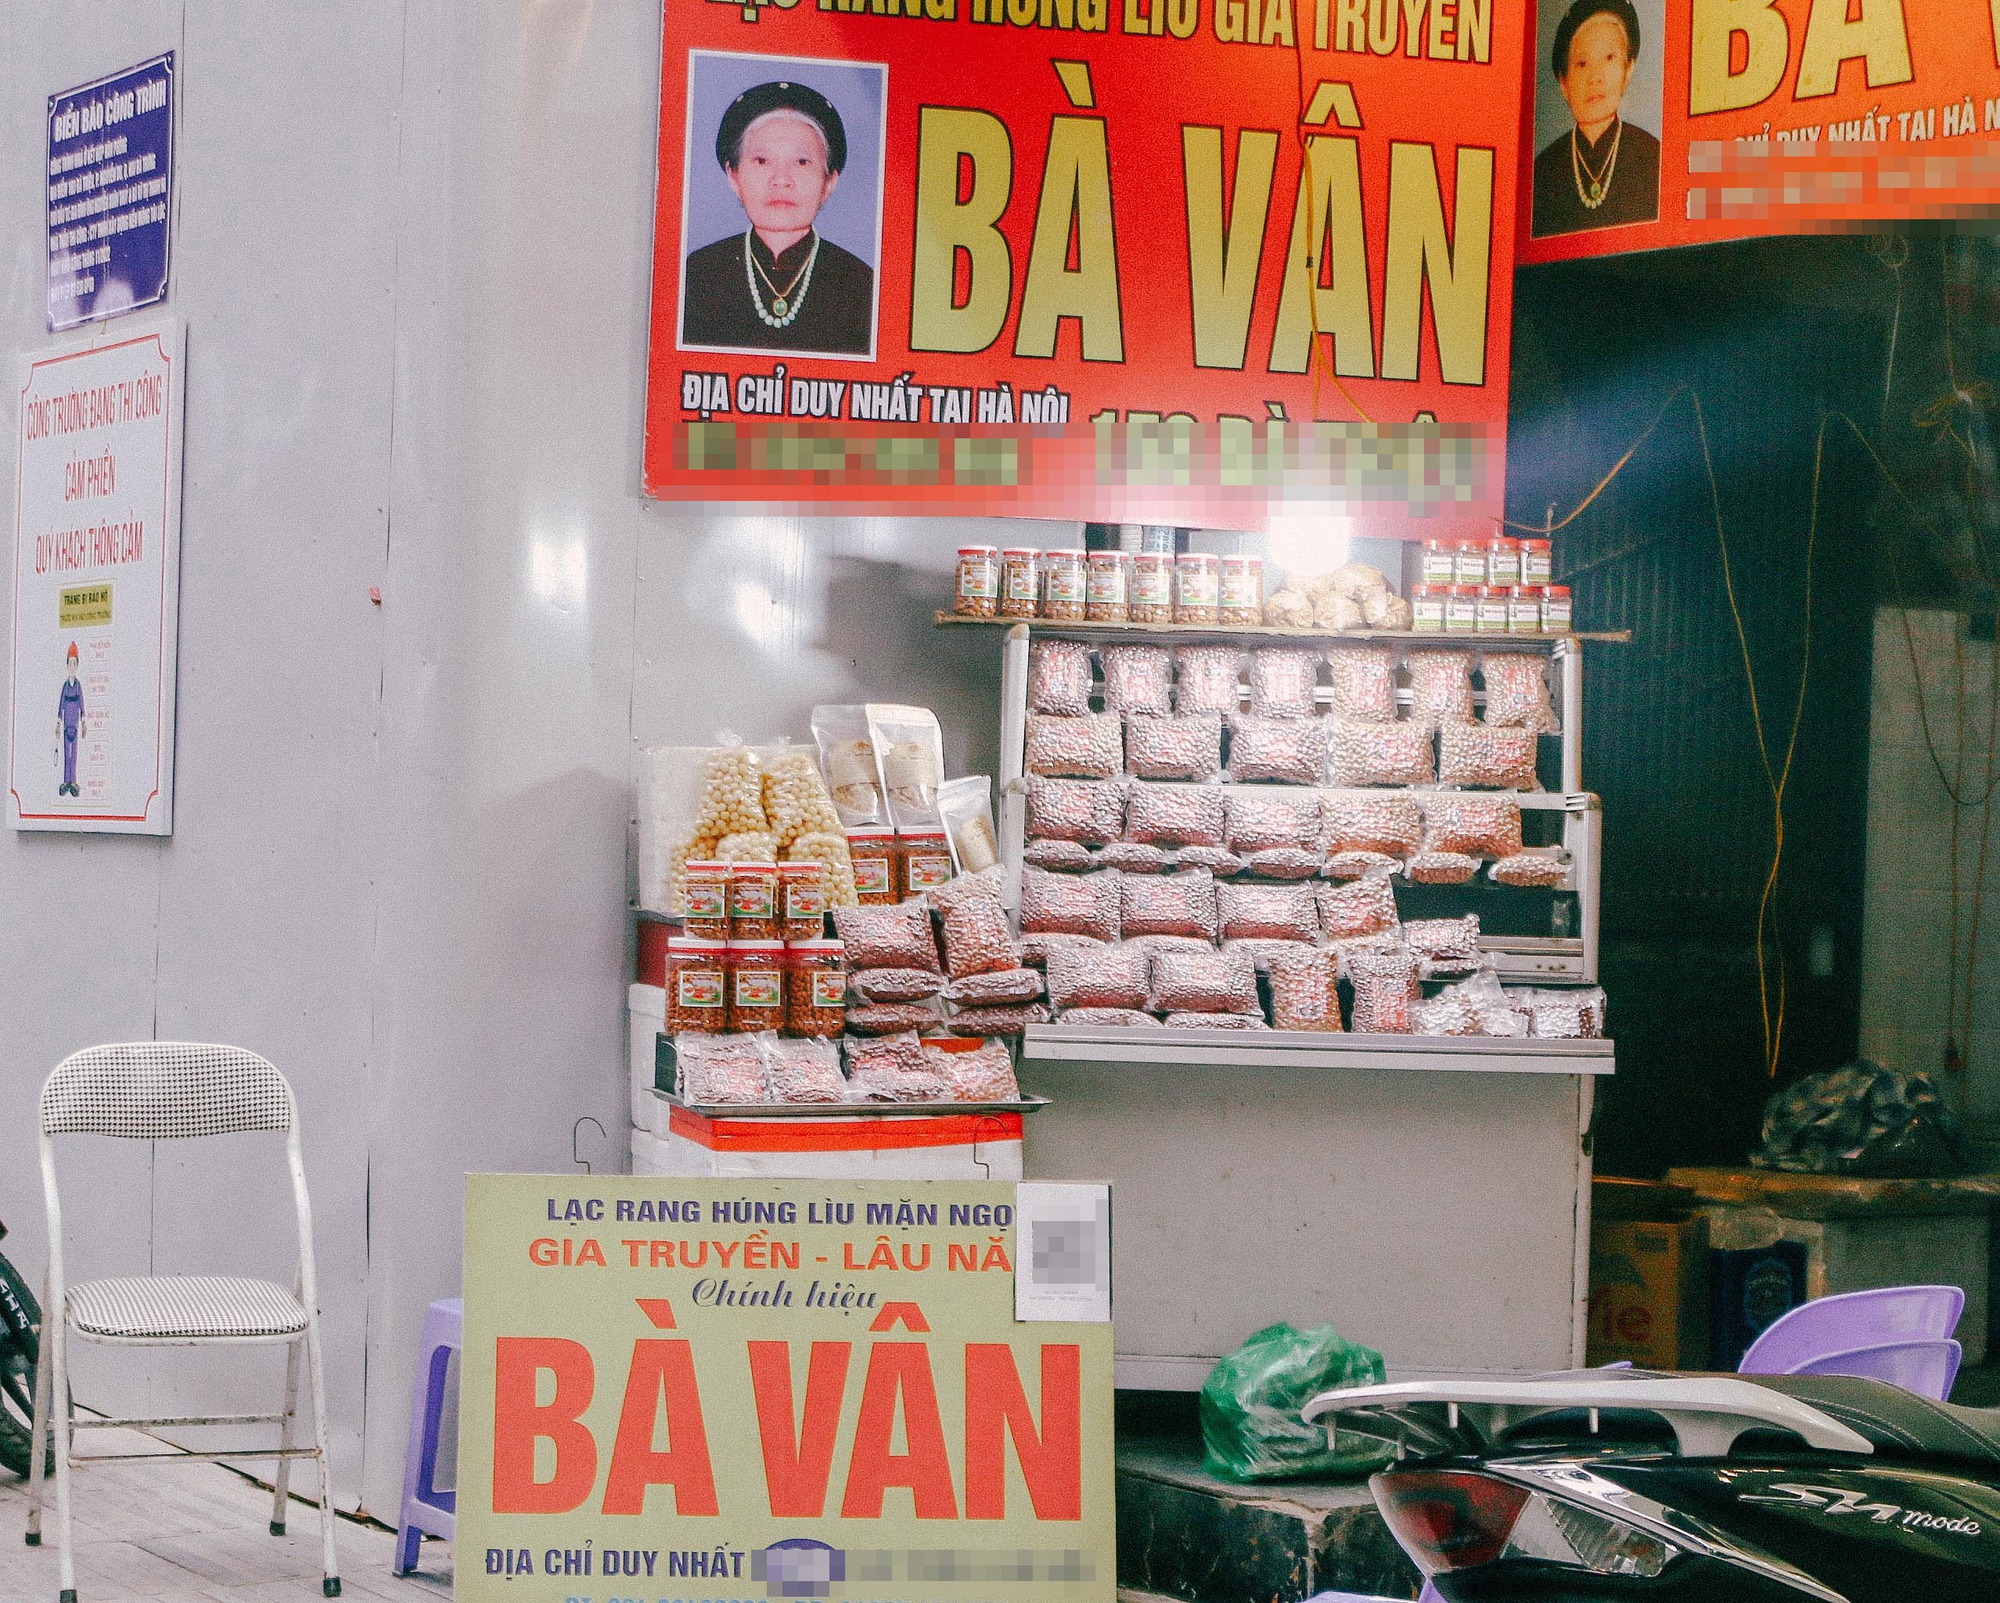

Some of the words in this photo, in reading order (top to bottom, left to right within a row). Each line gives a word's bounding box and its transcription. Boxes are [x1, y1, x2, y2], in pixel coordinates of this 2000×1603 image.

[81, 98, 104, 134] BÁO
[105, 90, 135, 126] CÔNG
[135, 79, 166, 115] TRÌNH
[1942, 95, 1978, 138] HÀ
[909, 60, 1127, 364] BÀ
[1181, 81, 1498, 387] VÂN
[27, 393, 51, 441] CÔNG
[90, 385, 116, 428] ĐANG
[118, 380, 134, 423] THI
[135, 369, 162, 419] CÔNG
[682, 371, 732, 420] ĐỊA
[736, 363, 787, 416] CHỈ
[789, 377, 848, 419] DUY
[850, 371, 926, 423] NHẤT
[977, 381, 1016, 424] HÀ
[56, 523, 87, 571] KHÁCH
[89, 518, 120, 568] THÔNG
[547, 1198, 605, 1227] LẠC
[616, 1200, 701, 1224] RANG
[712, 1197, 797, 1225] HÚNG
[808, 1198, 855, 1225] LÌU
[866, 1198, 938, 1231] MẶN
[949, 1204, 1014, 1232] NGỌ
[528, 1237, 608, 1268] GIA
[621, 1228, 800, 1270] TRUYỀN
[843, 1235, 932, 1272] LÂU
[948, 1236, 1013, 1273] NĂ
[692, 1278, 794, 1308] Chính
[805, 1280, 880, 1317] hiệu
[492, 1298, 720, 1517] BÀ
[747, 1302, 1082, 1521] VÂN
[1902, 1508, 1982, 1536] mode
[485, 1548, 534, 1581] ĐỊA
[544, 1539, 593, 1576] CHỈ
[602, 1550, 659, 1577] DUY
[668, 1542, 746, 1579] NHẤT
